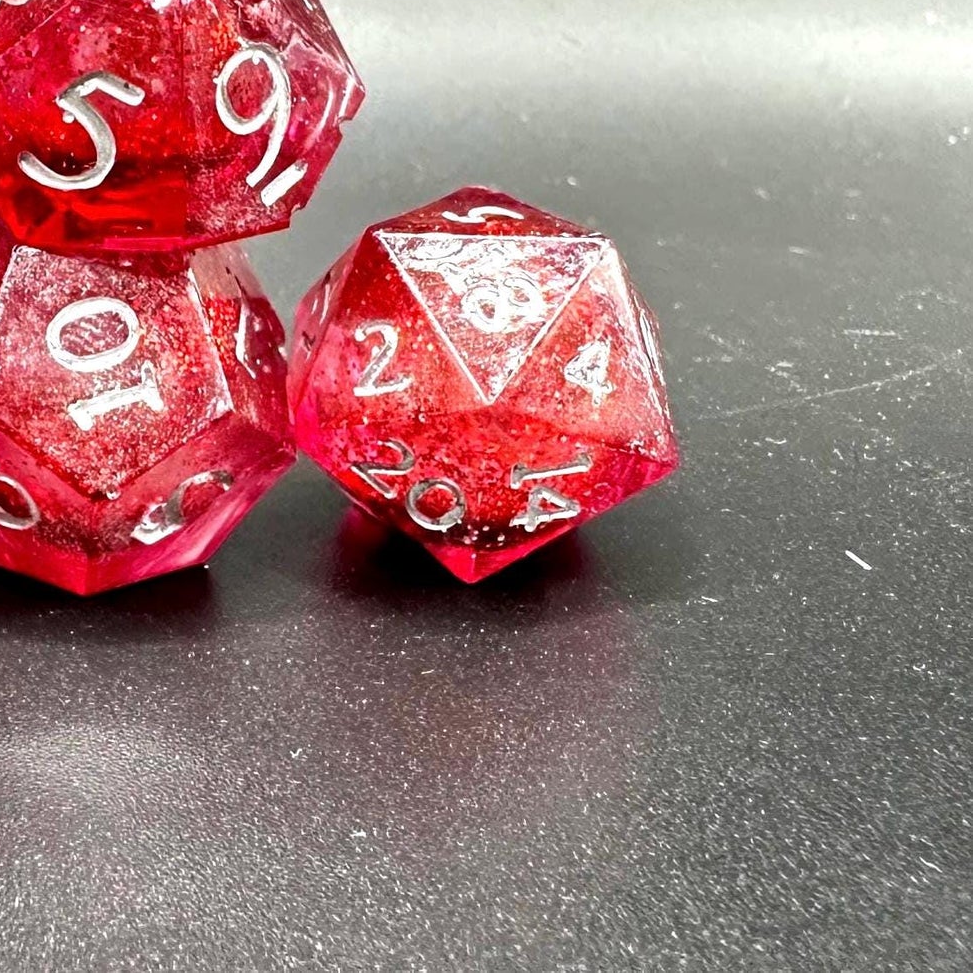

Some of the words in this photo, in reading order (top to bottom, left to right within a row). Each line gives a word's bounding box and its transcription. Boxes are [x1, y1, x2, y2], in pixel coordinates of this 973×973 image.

[18, 72, 145, 190] 5
[45, 297, 165, 431] 10
[354, 319, 413, 398] 2
[563, 338, 616, 406] 4
[350, 439, 469, 533] 20
